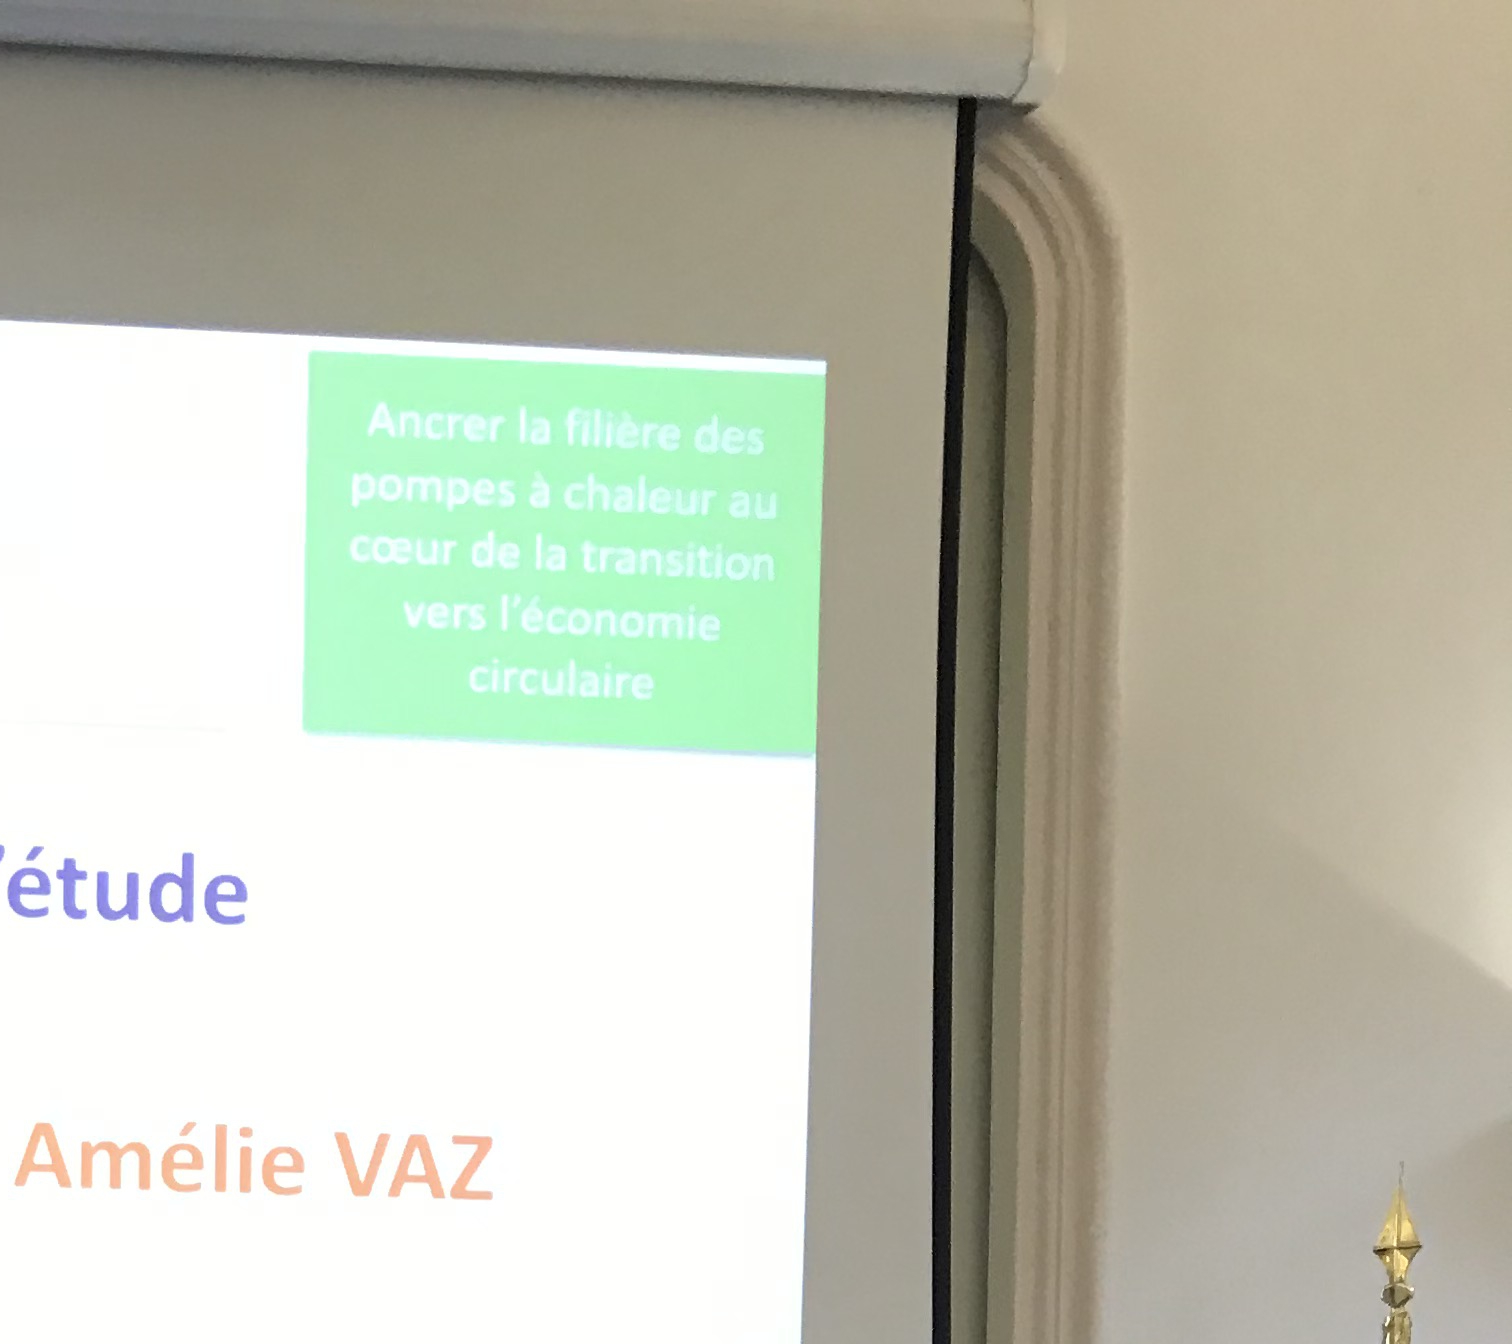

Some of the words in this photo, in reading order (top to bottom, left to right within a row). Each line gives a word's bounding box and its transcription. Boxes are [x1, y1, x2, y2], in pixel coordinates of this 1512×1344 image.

[367, 402, 506, 443] Ancrer
[519, 406, 551, 445] la
[566, 407, 681, 451] filière
[694, 413, 765, 456] des
[351, 471, 516, 512] pompes
[529, 471, 551, 509] à
[563, 473, 716, 516] chaleur
[728, 491, 778, 520] au
[350, 533, 457, 567] cœur
[471, 531, 521, 570] de
[535, 533, 567, 573] la
[582, 539, 776, 582] transition
[403, 601, 487, 632] vers
[500, 594, 721, 642] l’économie
[468, 659, 655, 700] circulaire
[13, 1121, 306, 1197] Amélie
[333, 1131, 495, 1201] VAZ
